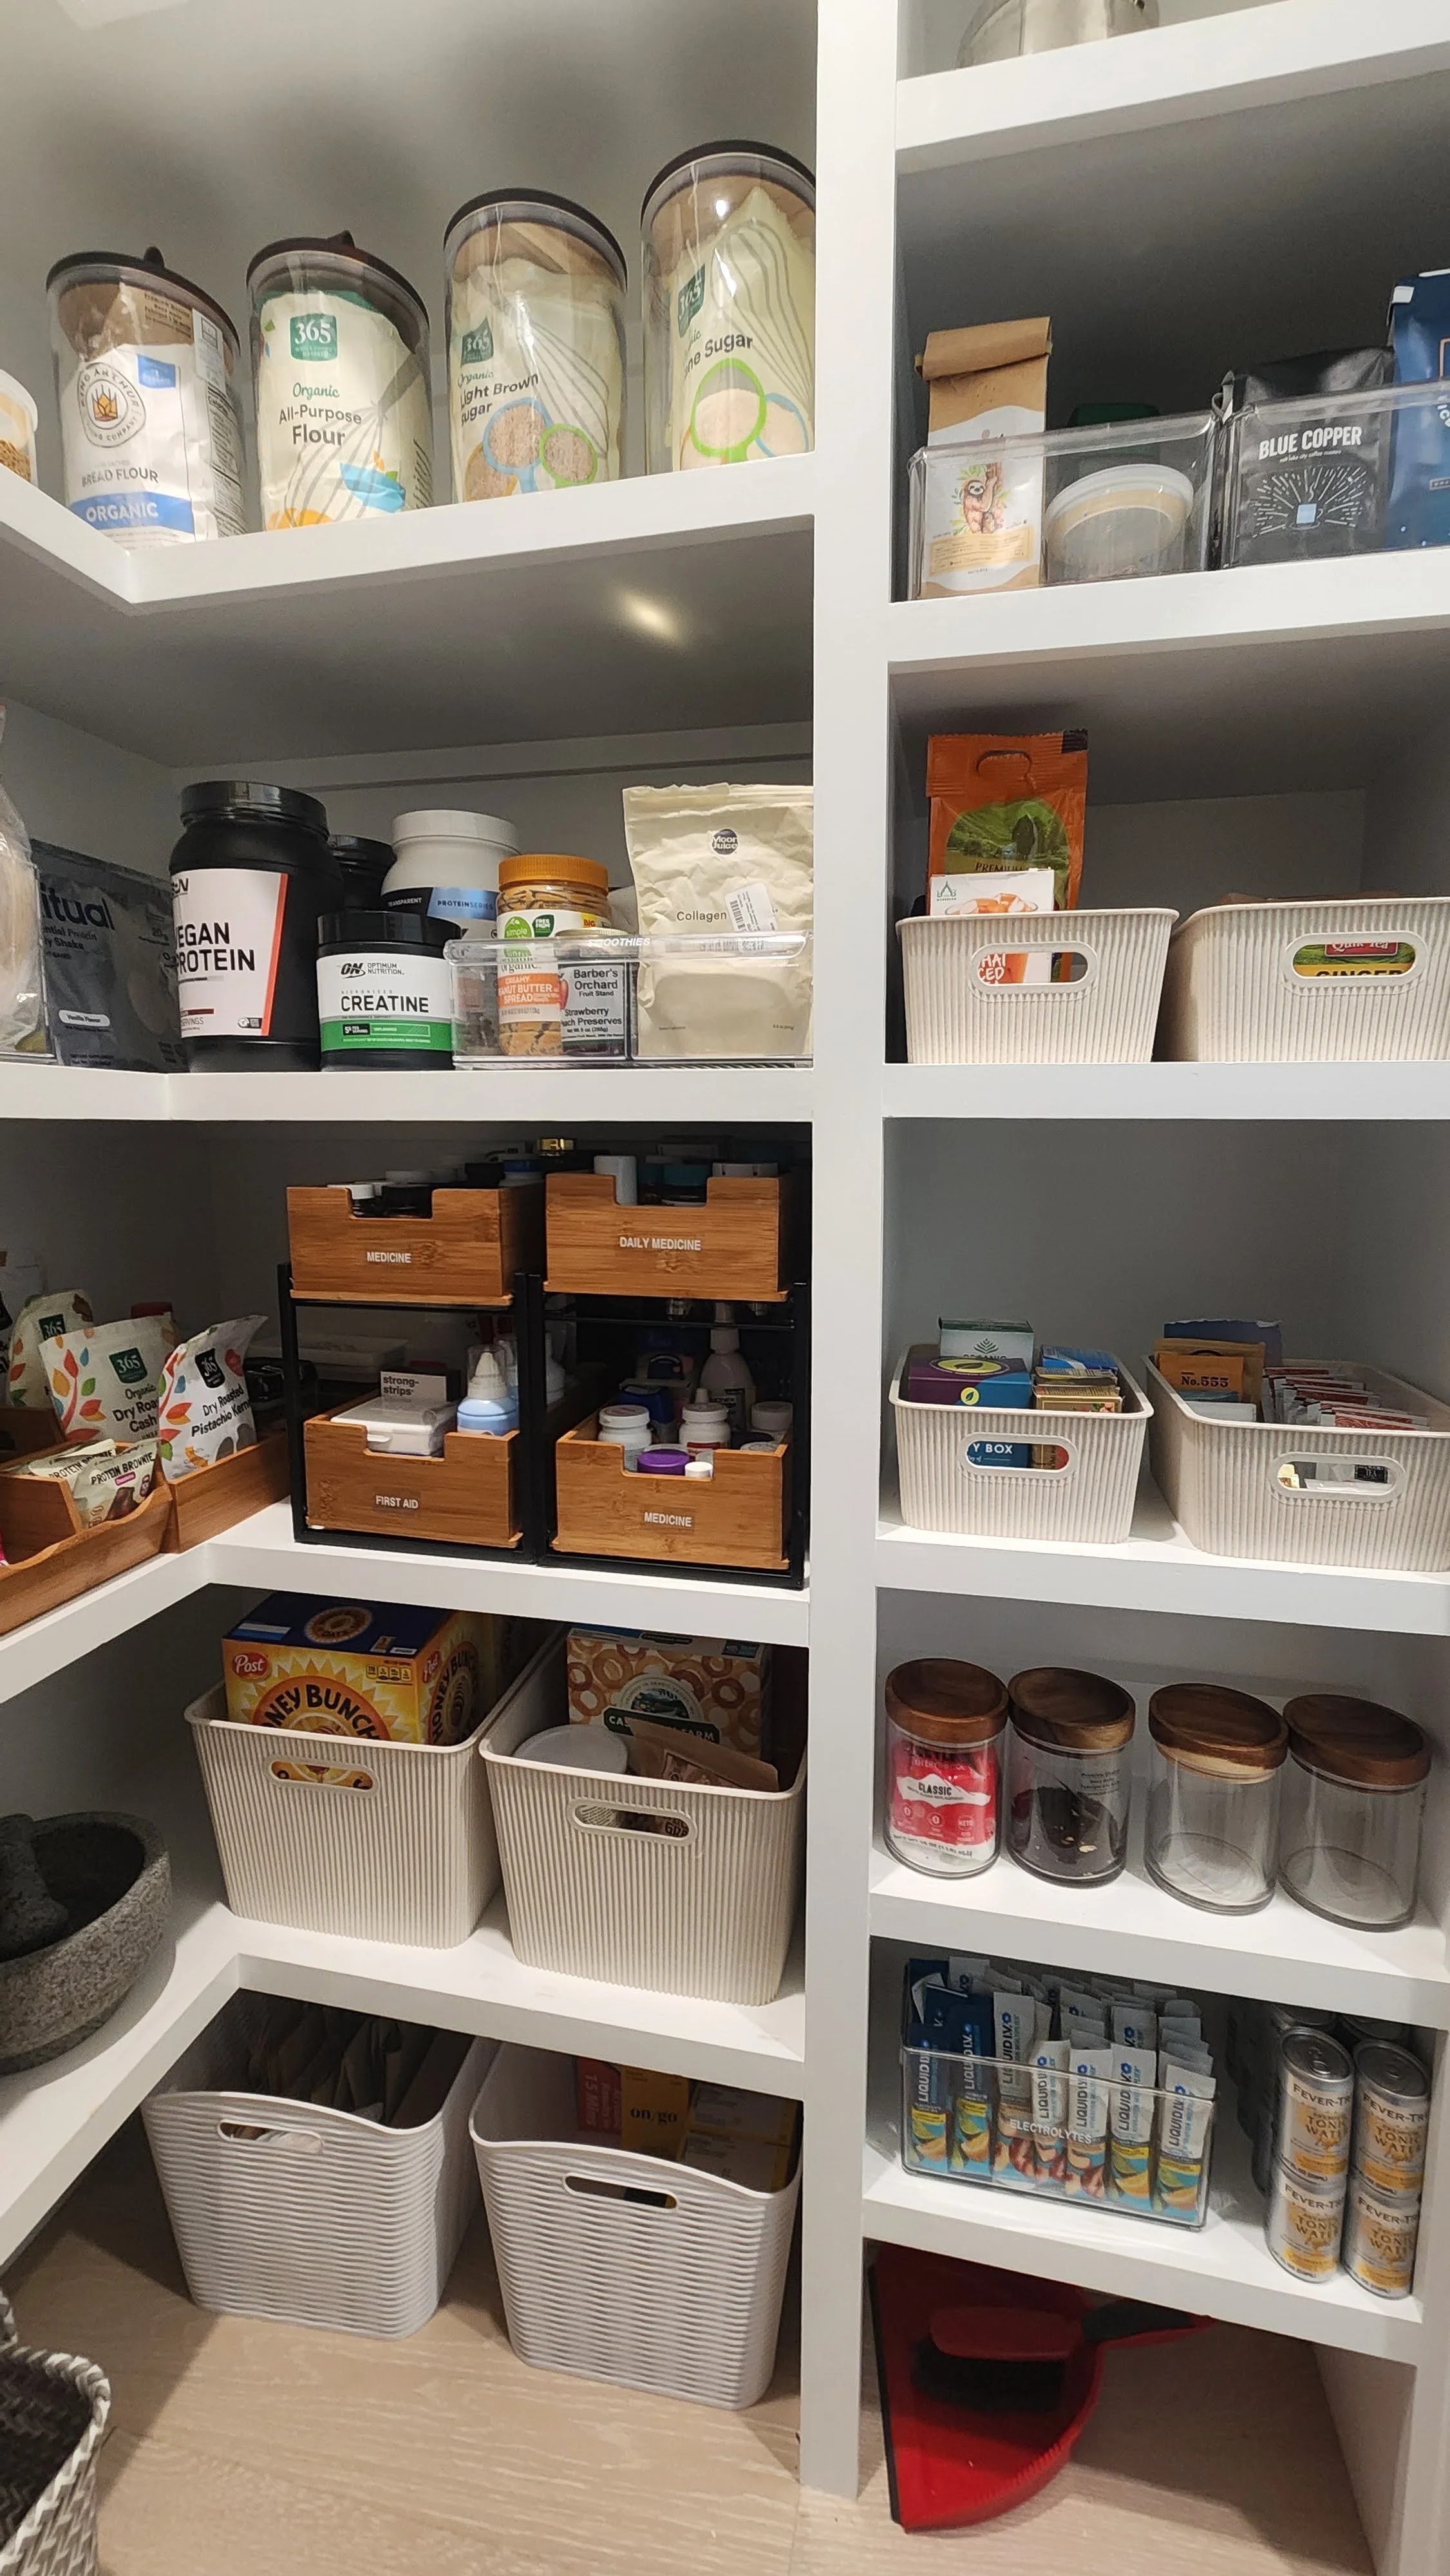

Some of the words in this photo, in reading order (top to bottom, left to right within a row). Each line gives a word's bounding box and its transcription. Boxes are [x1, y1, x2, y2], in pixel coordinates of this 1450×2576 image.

[296, 320, 331, 344] 365
[704, 334, 753, 358] Sugar
[292, 383, 340, 400] Organic
[493, 373, 539, 395] Brown
[279, 404, 362, 425] All-Purpose
[292, 423, 346, 445] Flour
[1259, 433, 1299, 460] BLUE
[1301, 426, 1362, 450] COPPER
[82, 469, 113, 488] BREAD
[116, 467, 159, 484] FLOUR
[86, 501, 159, 522] ORGANIC
[40, 882, 116, 931] itual
[583, 919, 596, 927] BIG
[677, 910, 727, 922] Collagen
[177, 922, 231, 948] EGAN
[506, 928, 527, 937] simple
[981, 953, 1006, 967] HAI
[341, 962, 365, 976] ON
[574, 968, 618, 978] Barber's
[978, 967, 1004, 980] CED
[505, 976, 530, 985] CREAMY
[518, 983, 552, 992] BUTTER
[574, 980, 618, 990] Orchard
[341, 995, 429, 1013] CREATINE
[504, 993, 533, 1004] SPREAD
[565, 1008, 609, 1017] Strawberry
[577, 1018, 622, 1026] Preserves
[619, 1236, 650, 1248] DAILY
[652, 1238, 701, 1251] MEDICINE
[366, 1252, 412, 1264] MEDICINE
[43, 1321, 64, 1338] 365
[116, 1354, 141, 1374] 365
[382, 1376, 419, 1388] strong-
[382, 1386, 411, 1396] strips
[202, 1402, 218, 1417] Dry
[218, 1383, 245, 1408] Roasted
[113, 1406, 135, 1422] Dry
[191, 1411, 233, 1437] Pistachio
[984, 1443, 1013, 1454] BOX
[91, 1464, 122, 1486] PROTEIN
[122, 1452, 155, 1473] BROWNIE
[375, 1495, 402, 1508] FIRST
[402, 1497, 419, 1510] AID
[644, 1511, 692, 1527] MEDICINE
[234, 1654, 265, 1674] Post
[918, 1781, 952, 1796] CLASSIC
[1009, 2117, 1092, 2145] ELECTROLYTES
